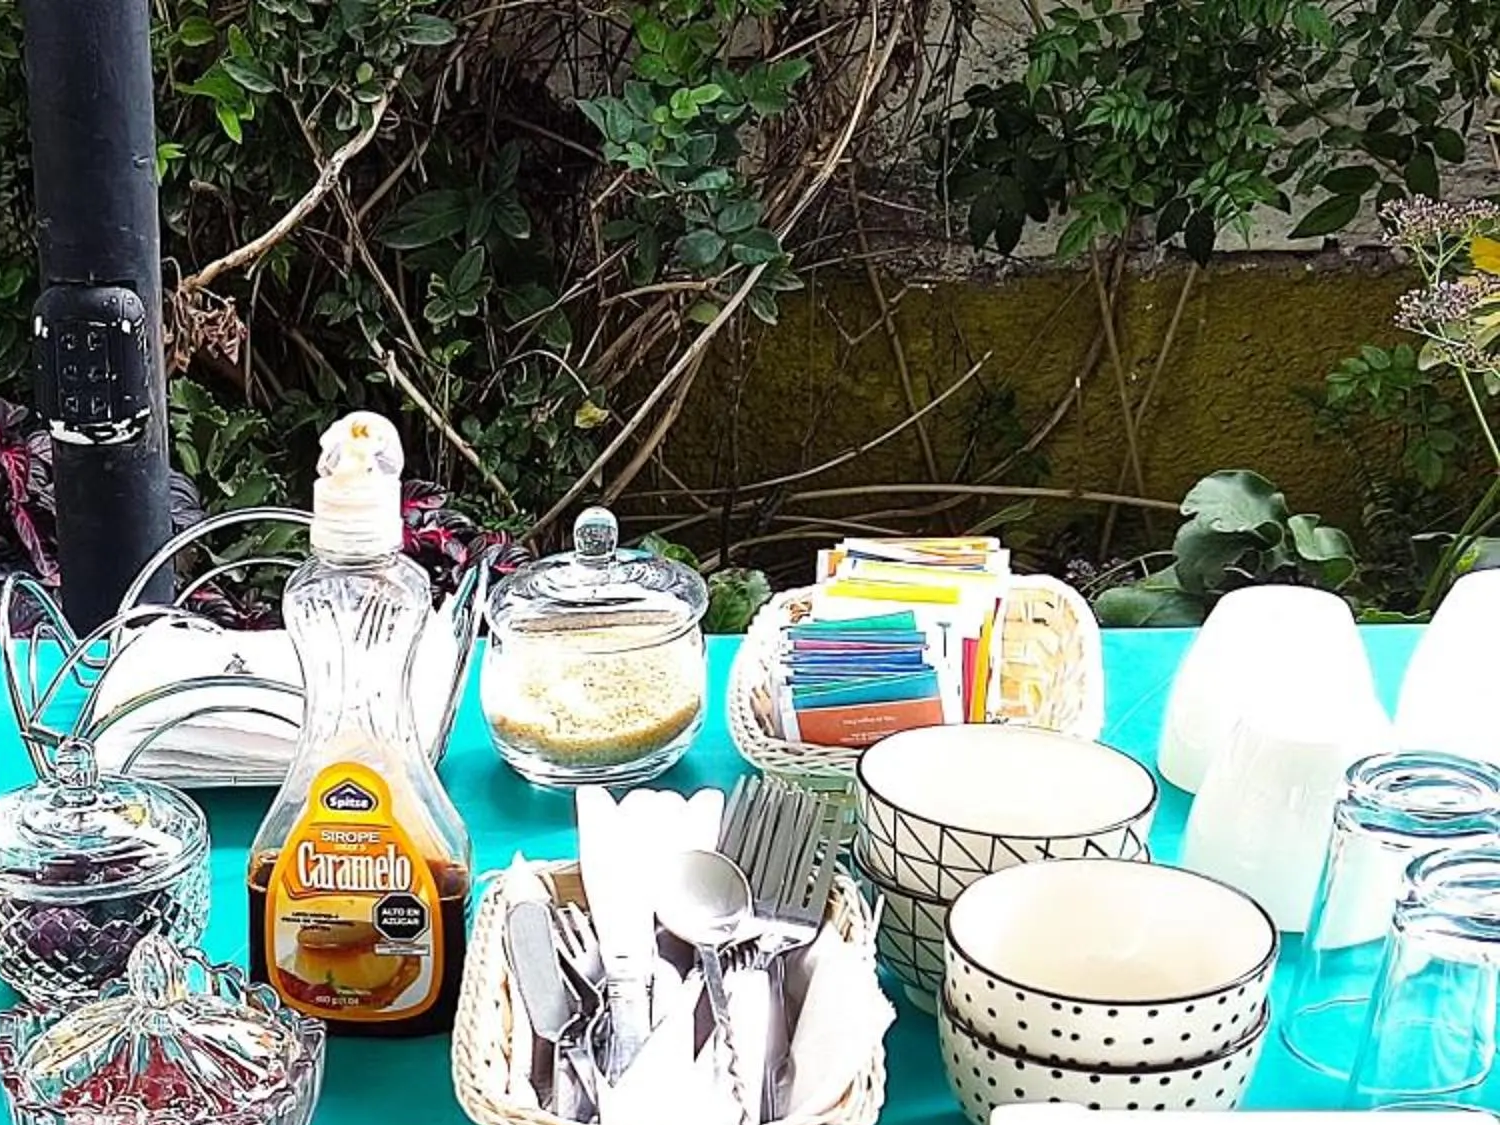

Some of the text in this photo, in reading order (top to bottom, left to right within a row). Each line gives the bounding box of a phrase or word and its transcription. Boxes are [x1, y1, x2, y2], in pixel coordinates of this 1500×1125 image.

[321, 831, 381, 843] SIROPE
[297, 841, 412, 891] Caramelo
[381, 907, 420, 916] ALTO EN
